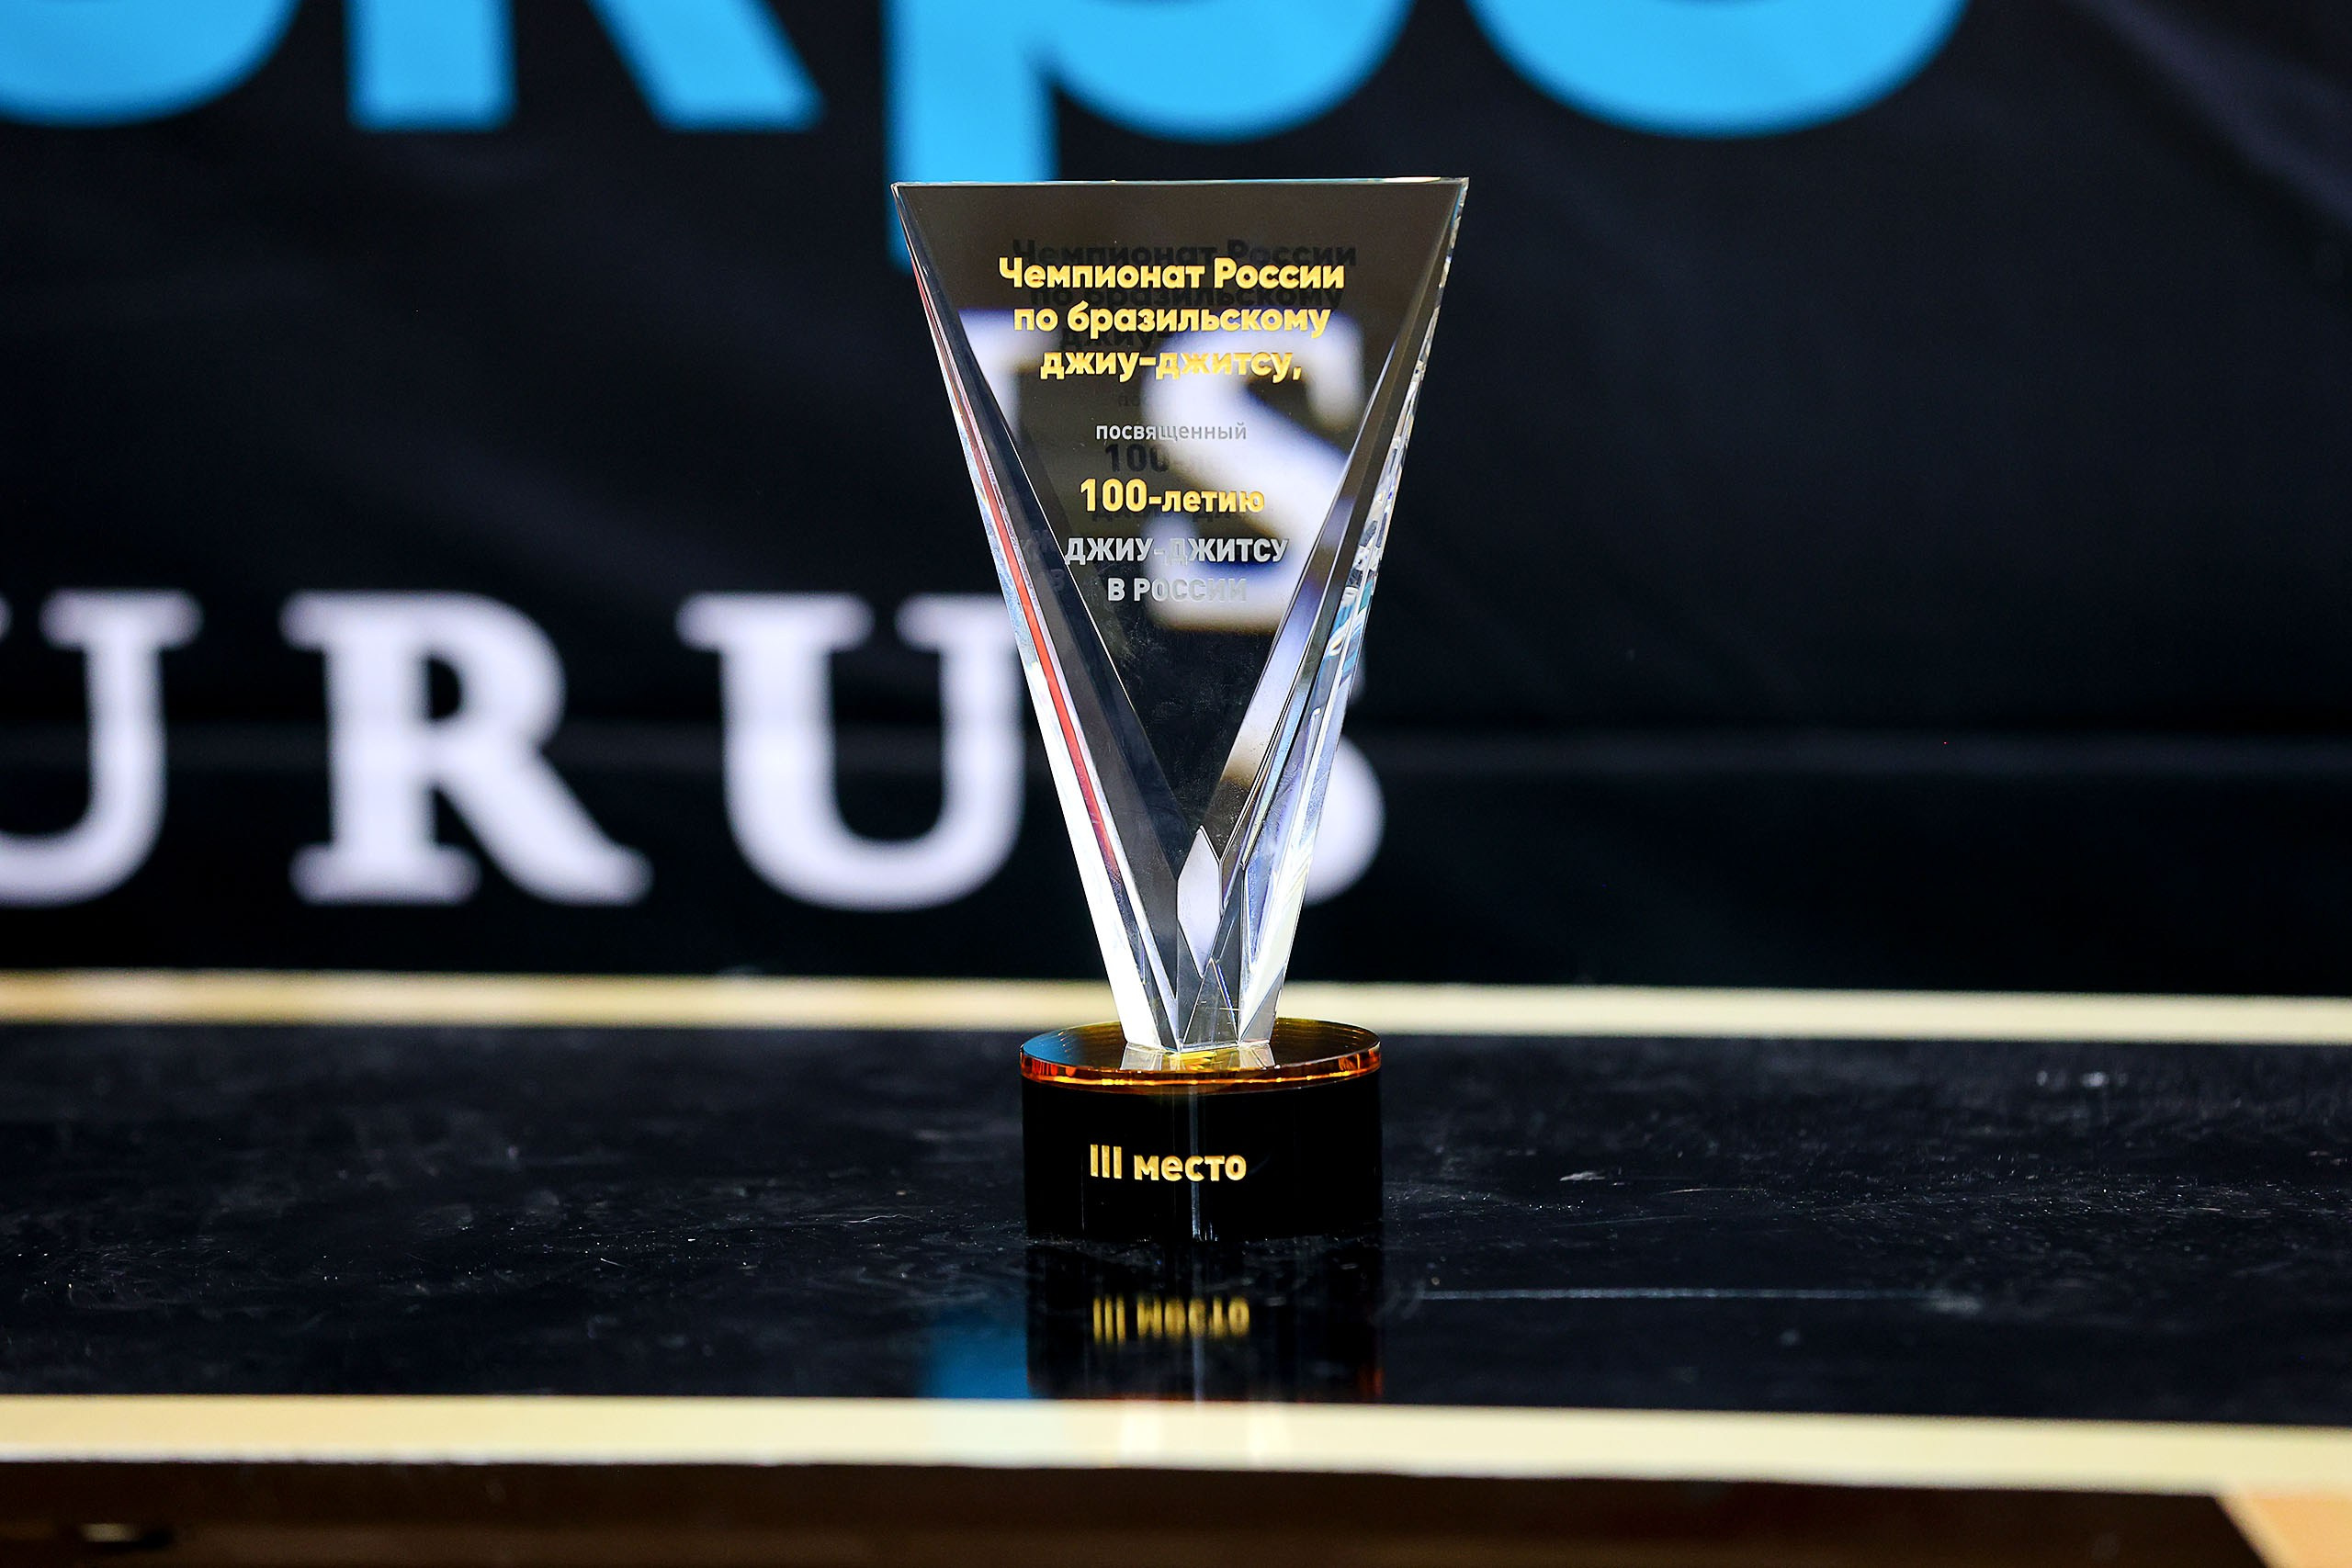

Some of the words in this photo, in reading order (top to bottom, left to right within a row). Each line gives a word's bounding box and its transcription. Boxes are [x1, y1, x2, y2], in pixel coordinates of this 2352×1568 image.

[998, 256, 1205, 289] Чемпионат
[1214, 256, 1345, 289] России
[1013, 308, 1058, 331] по
[1067, 300, 1330, 339] бразильскому
[1040, 351, 1303, 382] джиу-джитсу,
[1095, 422, 1247, 442] посвященный
[1080, 478, 1264, 513] 100-летию
[1065, 537, 1291, 565] ДЖИУ-ДЖИТСУ
[1108, 578, 1125, 602] В
[1134, 578, 1248, 603] РОССИИ
[1090, 1144, 1123, 1179] III
[1133, 1155, 1248, 1182] место
